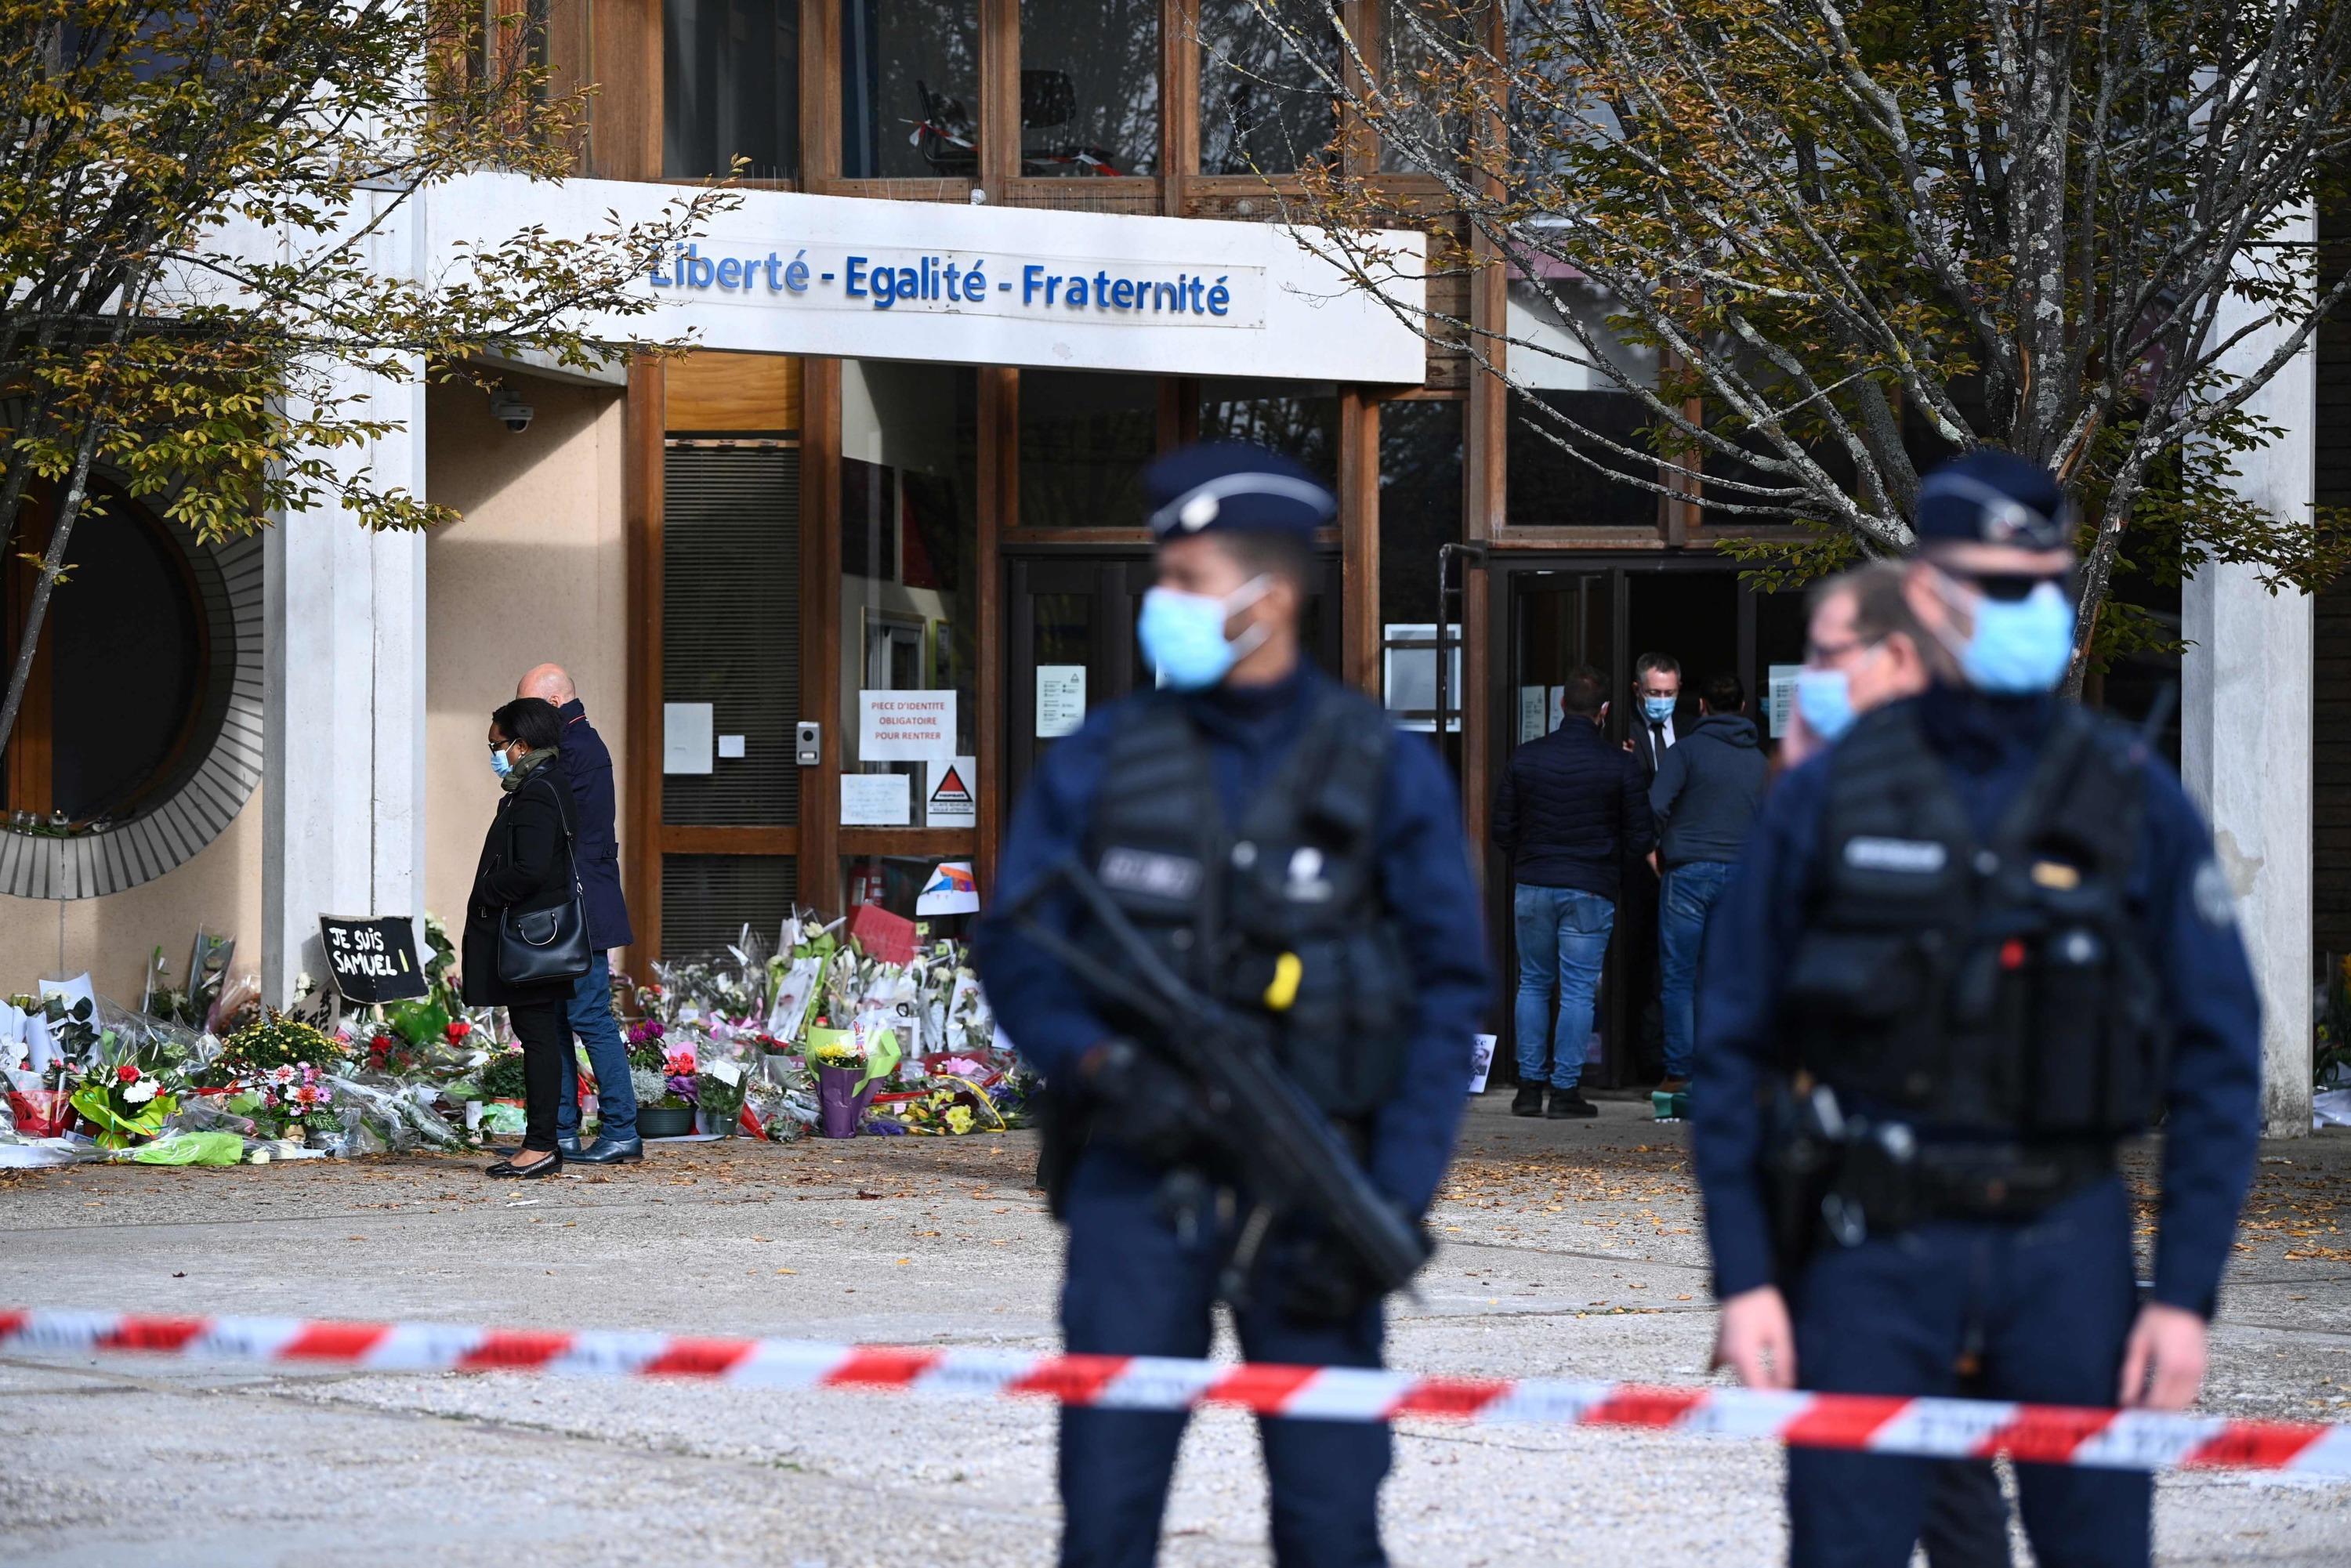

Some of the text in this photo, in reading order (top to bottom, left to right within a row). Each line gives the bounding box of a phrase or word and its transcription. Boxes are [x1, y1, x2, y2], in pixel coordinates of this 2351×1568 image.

[650, 241, 810, 292] Liberté
[846, 255, 987, 309] Egalité
[1023, 265, 1230, 316] Fraternité
[329, 927, 351, 949] JE
[333, 951, 397, 976] SAMUEL
